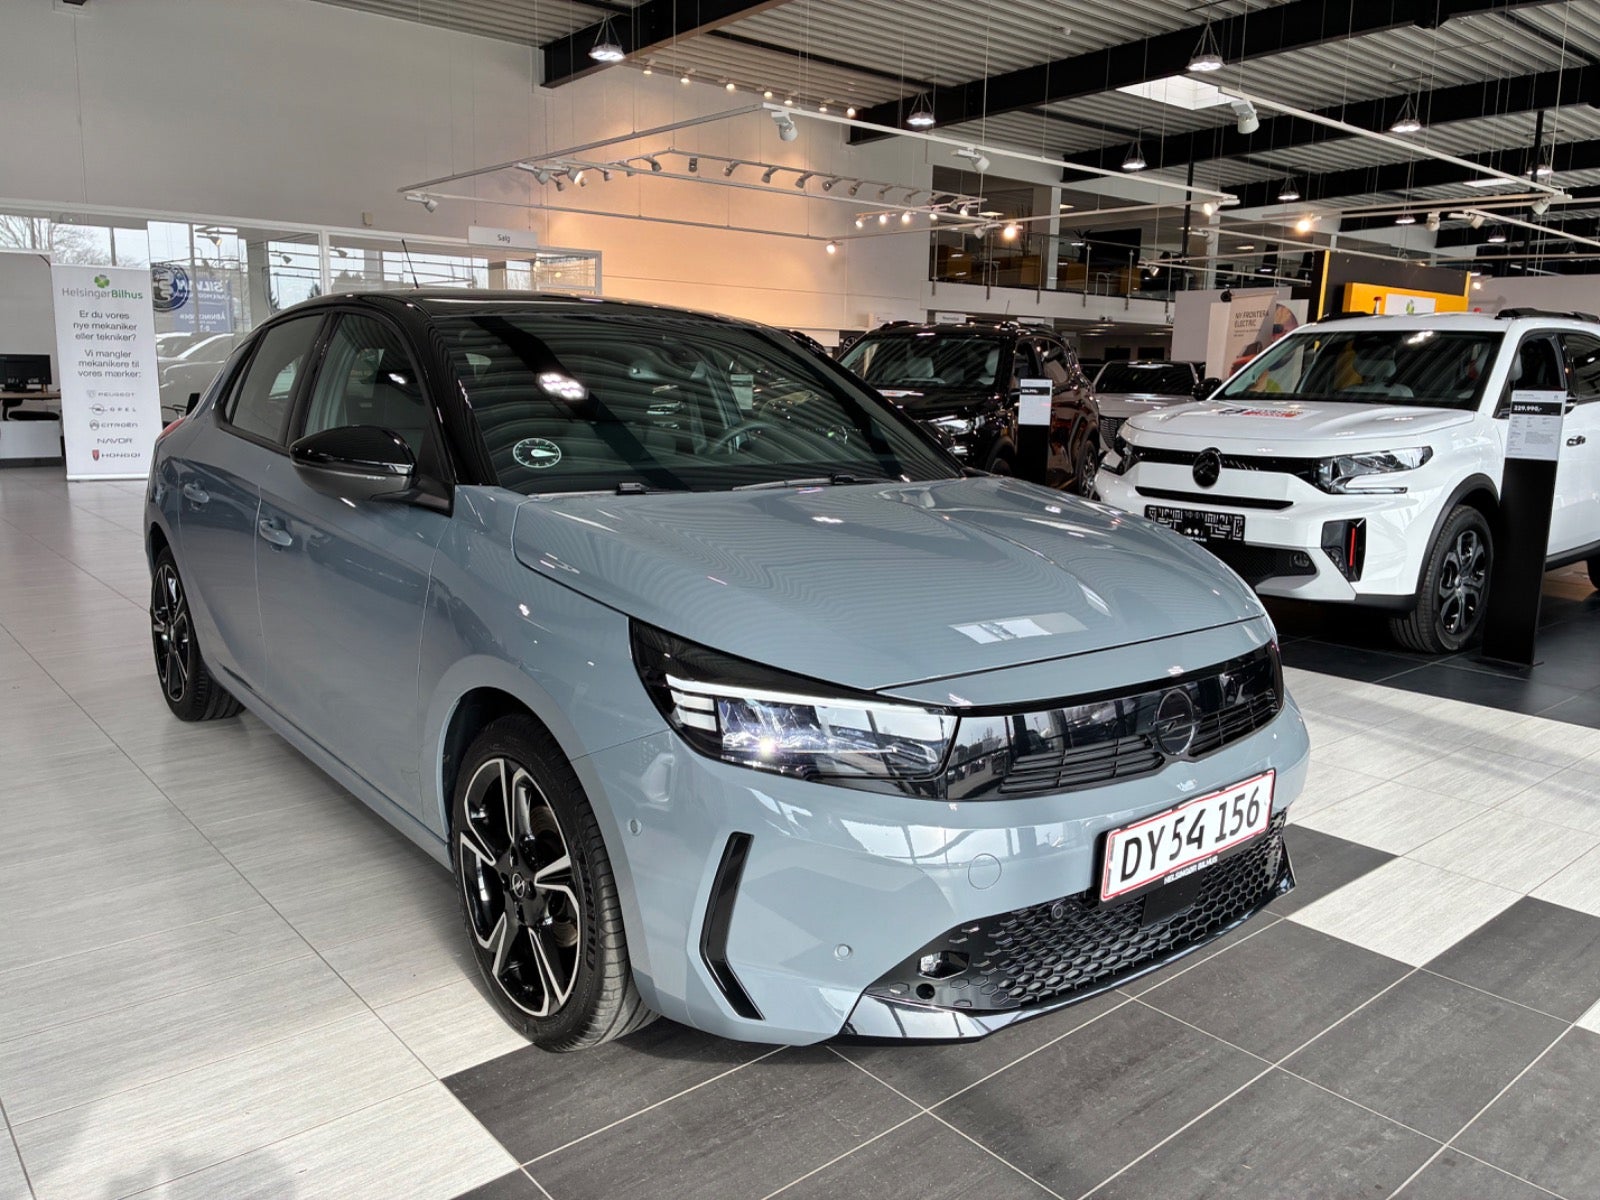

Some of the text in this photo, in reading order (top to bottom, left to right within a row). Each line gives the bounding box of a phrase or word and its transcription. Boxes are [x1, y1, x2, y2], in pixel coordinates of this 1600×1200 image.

[497, 233, 511, 243] Salg
[62, 287, 144, 300] HelsingørBilhus
[79, 310, 89, 318] Er
[73, 322, 137, 331] nye mekaniker
[96, 333, 137, 341] tekniker?
[84, 349, 132, 359] Vi mangler
[78, 360, 130, 368] mekanikere
[1120, 786, 1260, 882] DY 54 156
